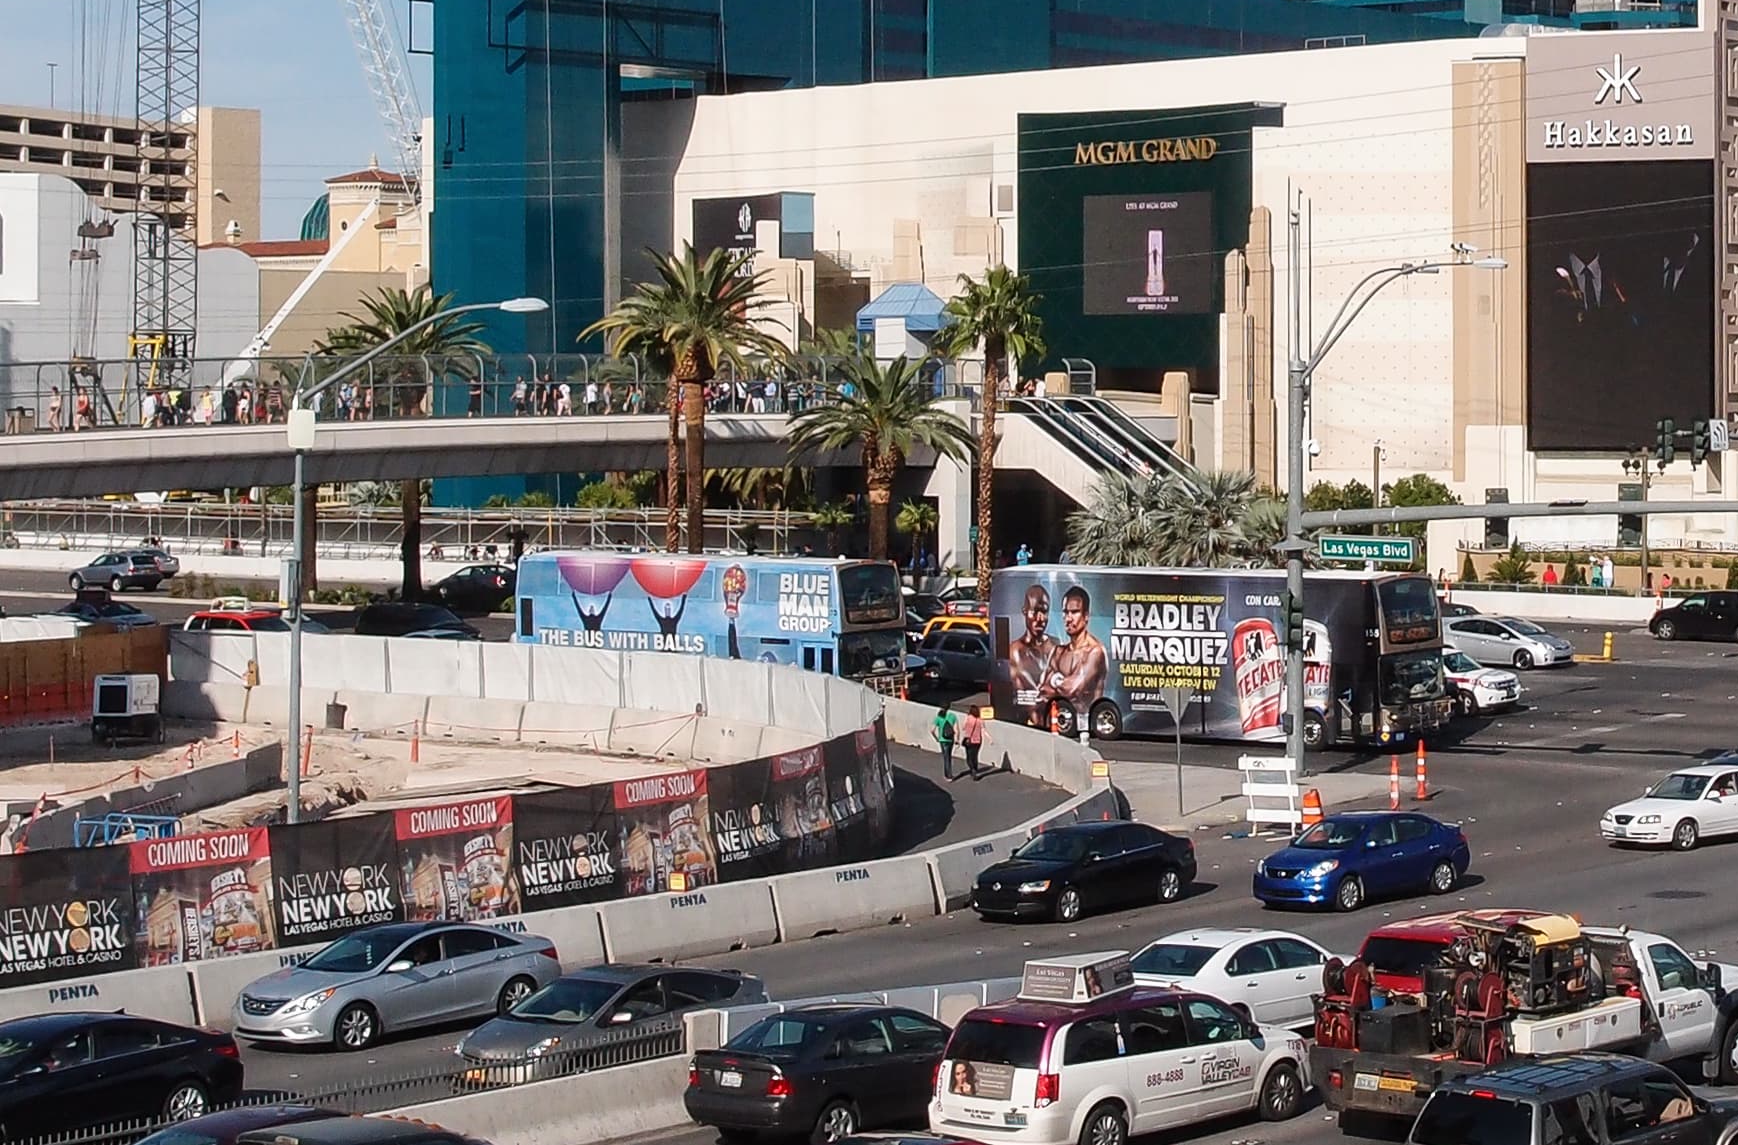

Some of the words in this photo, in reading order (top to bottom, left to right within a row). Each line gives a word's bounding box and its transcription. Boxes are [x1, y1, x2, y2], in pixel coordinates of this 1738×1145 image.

[1544, 120, 1694, 147] Hakkasan
[1074, 141, 1136, 165] MGM
[1141, 138, 1217, 162] GRAND
[1324, 543, 1344, 555] Las
[1349, 543, 1379, 558] Vegas
[1383, 544, 1408, 556] Blvd
[780, 573, 830, 594] BLUE
[779, 594, 829, 617] MAN
[1246, 595, 1261, 606] CON
[1263, 596, 1281, 606] CAR
[779, 617, 830, 633] GROUP
[1115, 603, 1221, 631] BRADLEY
[539, 629, 569, 645] THE
[574, 630, 604, 647] BUS
[609, 632, 648, 649] WITH
[654, 634, 704, 652] BALLS
[1111, 635, 1228, 665] MARQUEZ
[1120, 663, 1165, 676] SATURDAY,
[1211, 666, 1221, 677] 12
[1238, 660, 1283, 699] TECATE
[1305, 664, 1329, 684] ATE
[1123, 677, 1142, 687] LIVE
[1143, 678, 1157, 688] ON
[626, 779, 666, 803] COMING
[667, 774, 695, 796] SOON
[411, 807, 459, 834] COMING
[462, 801, 497, 826] SOON
[148, 838, 206, 866] COMING
[210, 833, 249, 859] SOON
[520, 837, 560, 864] NEW
[521, 859, 563, 886] NEW
[836, 868, 870, 883] PENTA
[280, 870, 328, 900] NEW
[526, 886, 540, 897] LAS
[540, 883, 563, 895] VEGAS
[282, 894, 331, 924] NEW
[670, 893, 708, 909] PENTA
[0, 904, 49, 935] NEW
[284, 925, 300, 936] LAS
[300, 921, 329, 934] VEGAS
[329, 917, 353, 930] HOTEL
[0, 931, 51, 962] NEW
[14, 959, 46, 972] VEGAS
[47, 955, 76, 968] HOTEL
[77, 954, 86, 965] &
[86, 950, 122, 963] CASINO
[49, 984, 99, 1003] PENTA
[1212, 1057, 1240, 1073] VIRGIN
